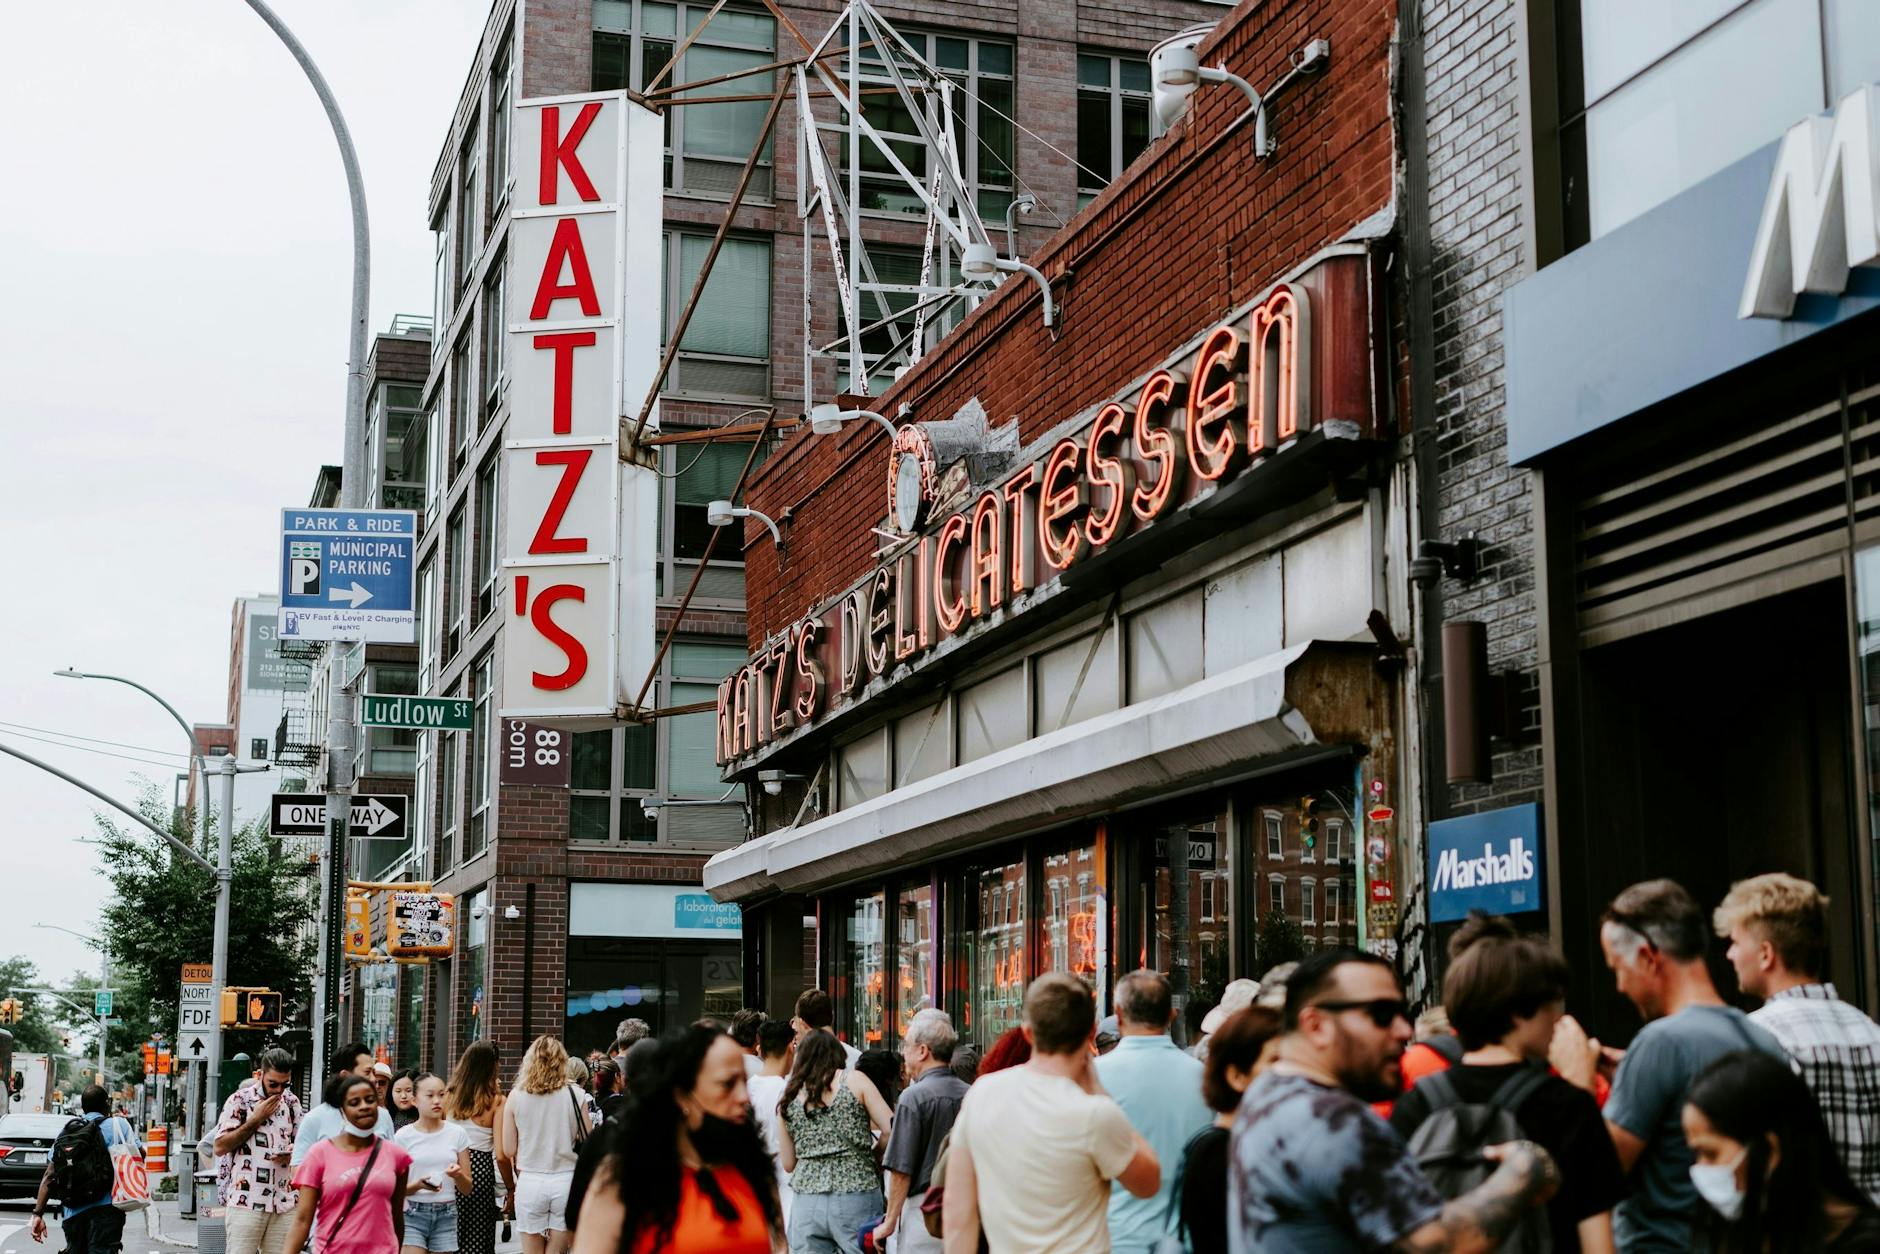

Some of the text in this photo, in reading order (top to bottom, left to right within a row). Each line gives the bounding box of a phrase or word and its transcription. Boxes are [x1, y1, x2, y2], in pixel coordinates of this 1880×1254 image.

[514, 102, 604, 692] KATZ'S
[295, 517, 402, 532] PARK & RIDE
[329, 542, 406, 558] MUNICIPAL
[329, 560, 391, 576] PARKING
[291, 559, 319, 594] P
[313, 613, 331, 621] Fast
[375, 615, 412, 625] Charging
[716, 619, 822, 767] KATZ'S
[363, 698, 468, 725] Ludlow St
[290, 806, 386, 825] ONE WAY
[1432, 837, 1534, 893] Marshalls
[683, 898, 738, 913] laboratorio
[184, 968, 212, 978] DETOU
[183, 987, 210, 999] NORT
